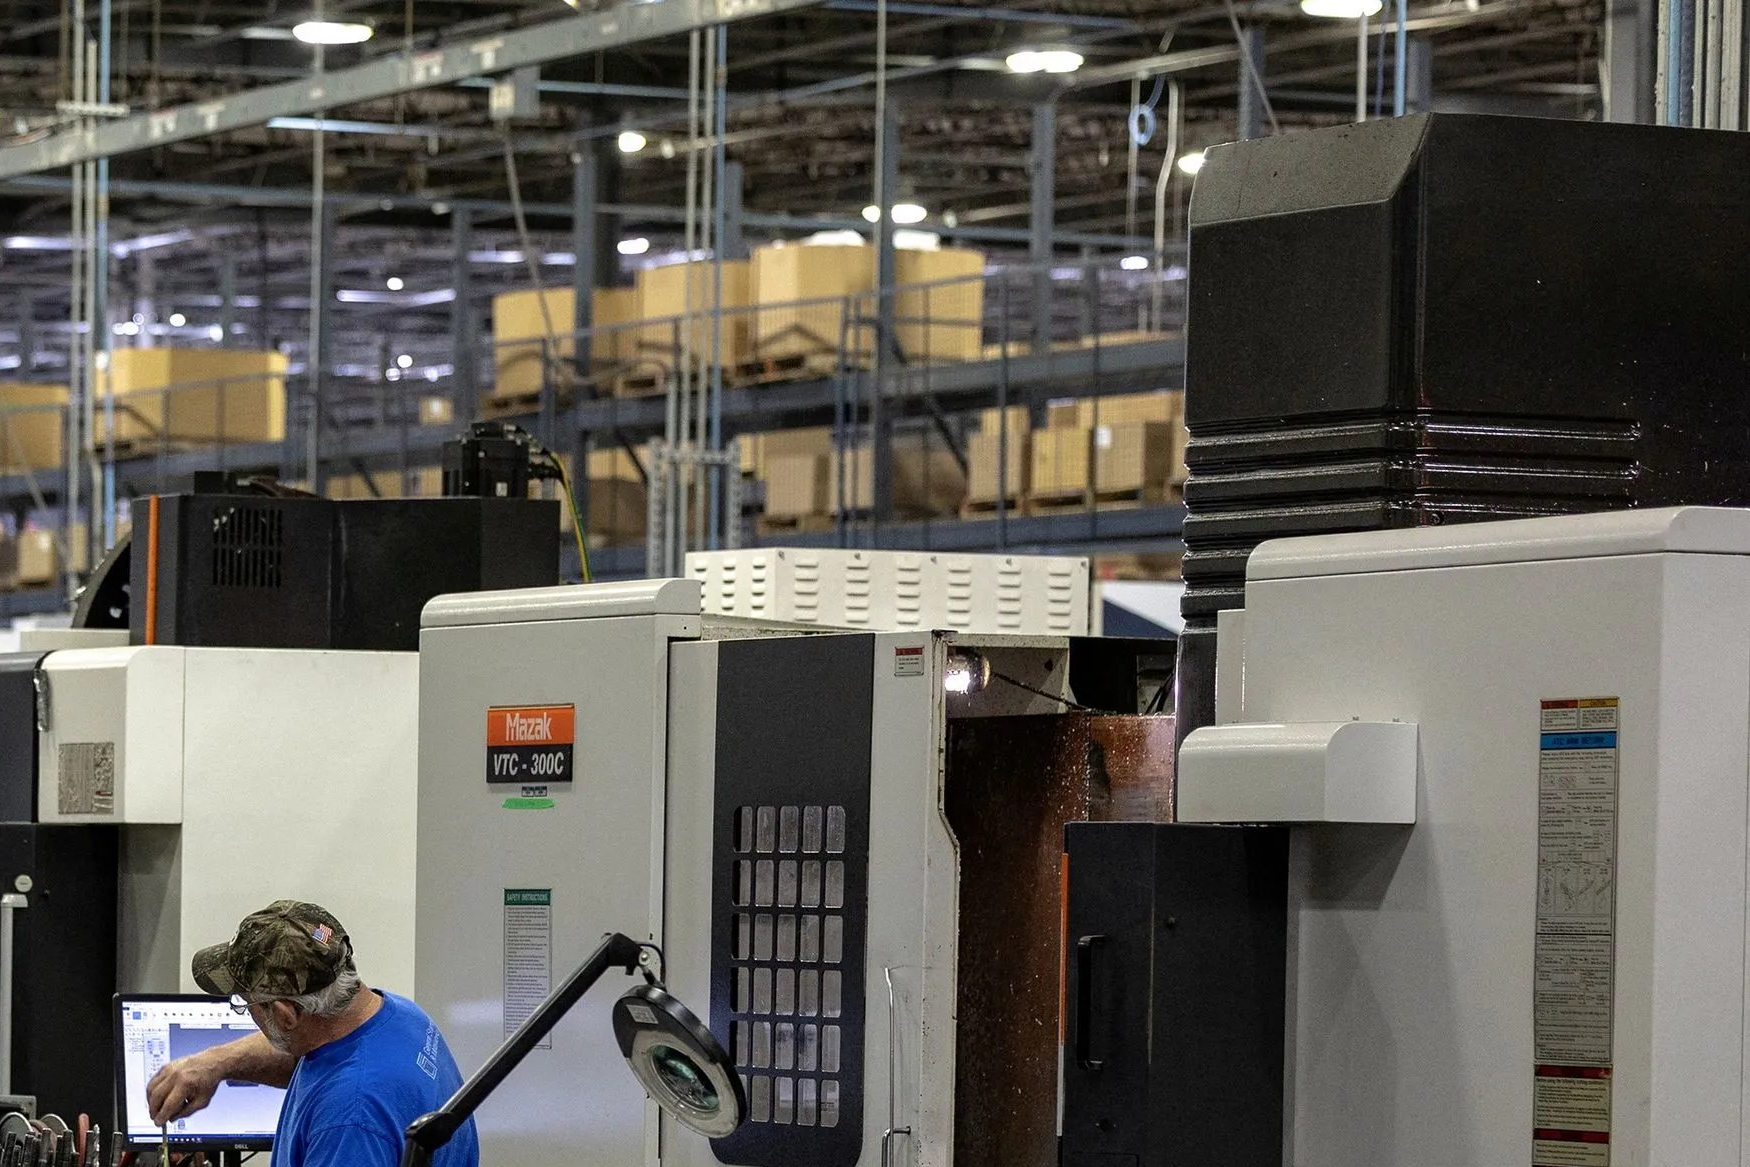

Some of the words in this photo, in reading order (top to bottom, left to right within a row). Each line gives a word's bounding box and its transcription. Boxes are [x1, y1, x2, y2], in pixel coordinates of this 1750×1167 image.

[506, 712, 552, 741] Mazak
[494, 753, 518, 775] VTC
[531, 752, 564, 775] 300C
